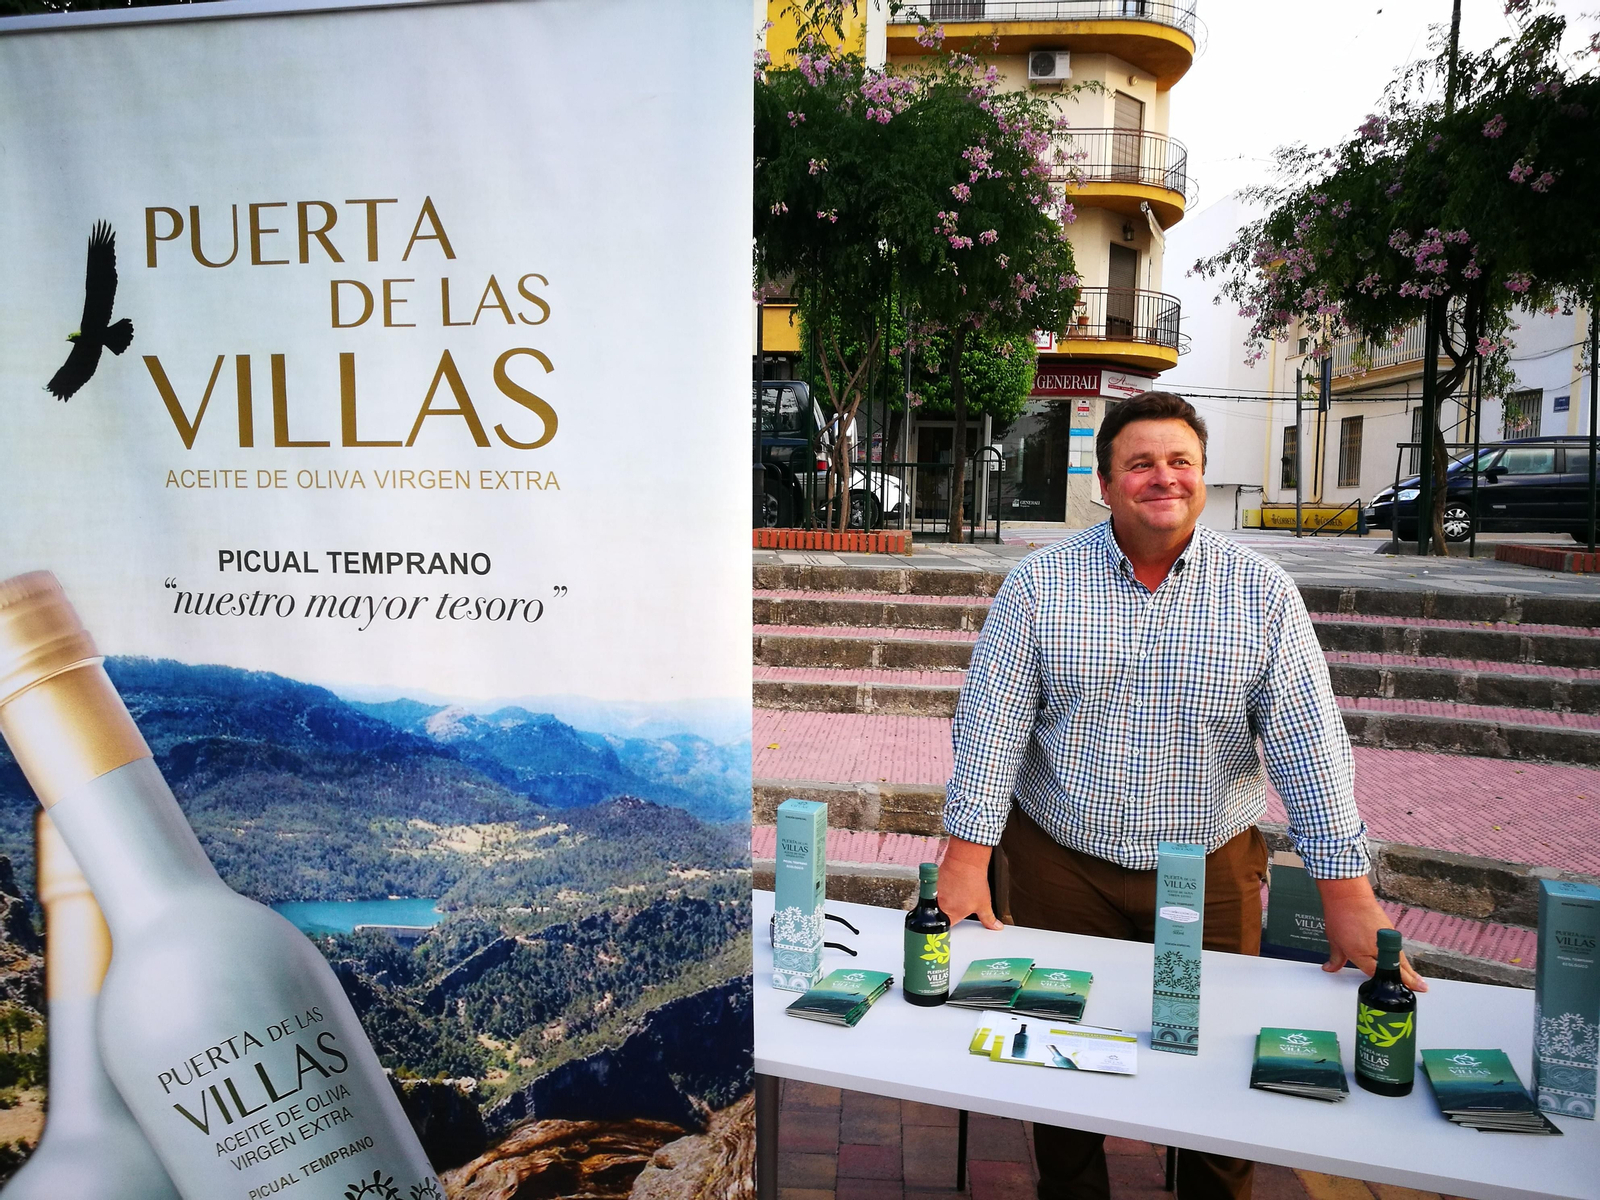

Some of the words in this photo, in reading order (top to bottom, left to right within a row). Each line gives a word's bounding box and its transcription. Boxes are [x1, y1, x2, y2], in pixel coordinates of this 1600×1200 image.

[145, 196, 457, 268] PUERTA
[331, 279, 416, 328] DE
[441, 273, 551, 326] LAS
[142, 347, 559, 450] VILLAS
[1036, 374, 1098, 390] GENERALI
[165, 470, 248, 489] ACEITE
[256, 469, 288, 489] DE
[296, 469, 366, 490] OLIVA
[373, 469, 471, 490] VIRGEN
[479, 470, 561, 491] EXTRA
[218, 549, 319, 574] PICUAL
[326, 550, 491, 575] TEMPRANO
[303, 594, 429, 632] mayor
[781, 843, 809, 854] VILLAS
[1163, 879, 1197, 890] VILLAS
[1555, 935, 1596, 949] VILLAS
[927, 970, 949, 982] VILLAS
[157, 1030, 264, 1094] PUERTA
[266, 1018, 295, 1042] DE
[295, 1006, 324, 1030] LAS
[1359, 1049, 1390, 1066] VILLAS
[172, 1031, 349, 1136] VILLAS
[216, 1119, 275, 1157] ACEITE
[275, 1104, 304, 1128] DE
[306, 1084, 351, 1113] OLIVA
[230, 1132, 297, 1171] VIRGEN
[298, 1106, 354, 1141] EXTRA
[248, 1173, 300, 1200] PICUAL
[299, 1135, 374, 1178] TEMPRANO
